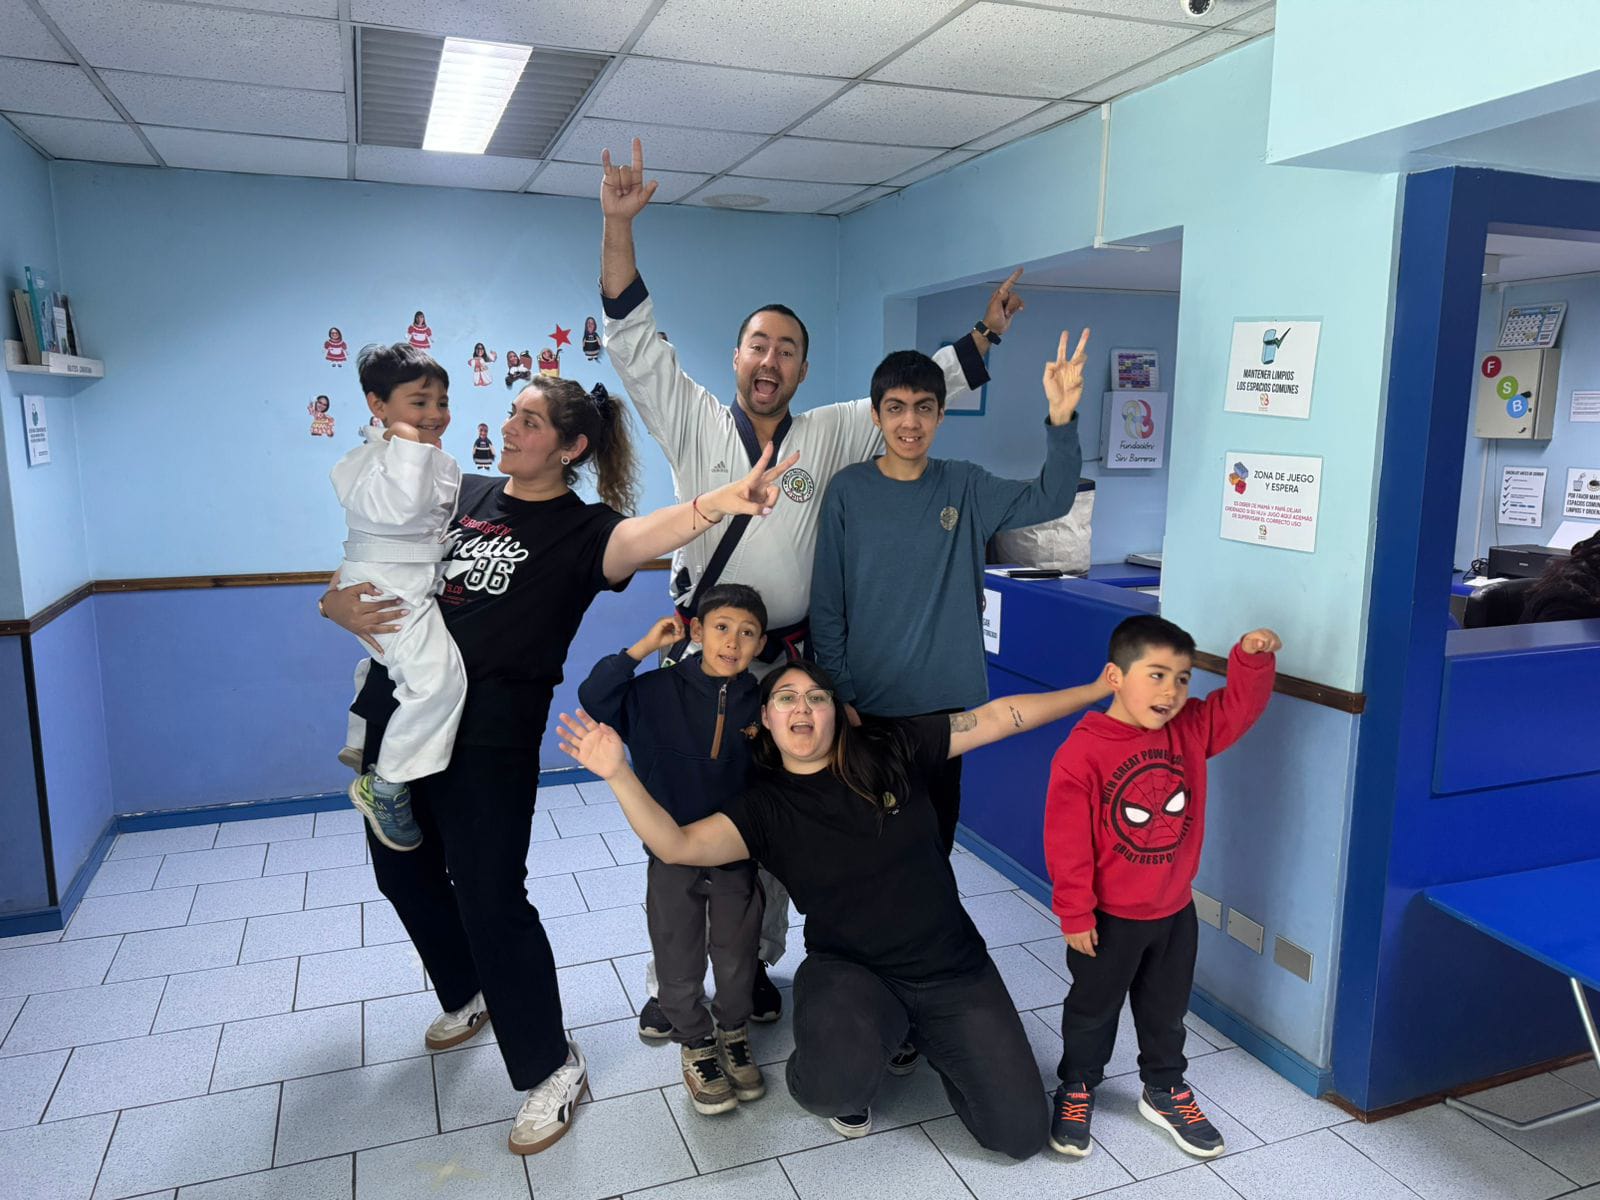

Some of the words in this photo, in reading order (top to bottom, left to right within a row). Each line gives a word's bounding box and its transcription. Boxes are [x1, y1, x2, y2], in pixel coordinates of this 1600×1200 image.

[1487, 361, 1496, 374] F
[1242, 369, 1272, 380] MANTENER
[1271, 371, 1295, 381] LIMPIOS
[1236, 381, 1246, 391] LOS
[1246, 382, 1271, 393] ESPACIOS
[1271, 384, 1299, 394] COMUNES
[1502, 381, 1512, 394] S
[1512, 400, 1523, 412] B
[1120, 440, 1154, 450] Fundación
[1114, 453, 1127, 462] Sin
[1129, 453, 1157, 462] Barreras
[1253, 470, 1274, 480] ZONA
[1274, 472, 1285, 481] DE
[1286, 473, 1315, 483] JUEGO
[1265, 482, 1270, 490] Y
[1271, 483, 1299, 493] ESPERA
[1567, 499, 1586, 507] ESPACIOS
[464, 556, 515, 595] 86
[1102, 780, 1118, 805] WITH
[1112, 753, 1141, 780] GREAT
[1140, 748, 1170, 761] POWE
